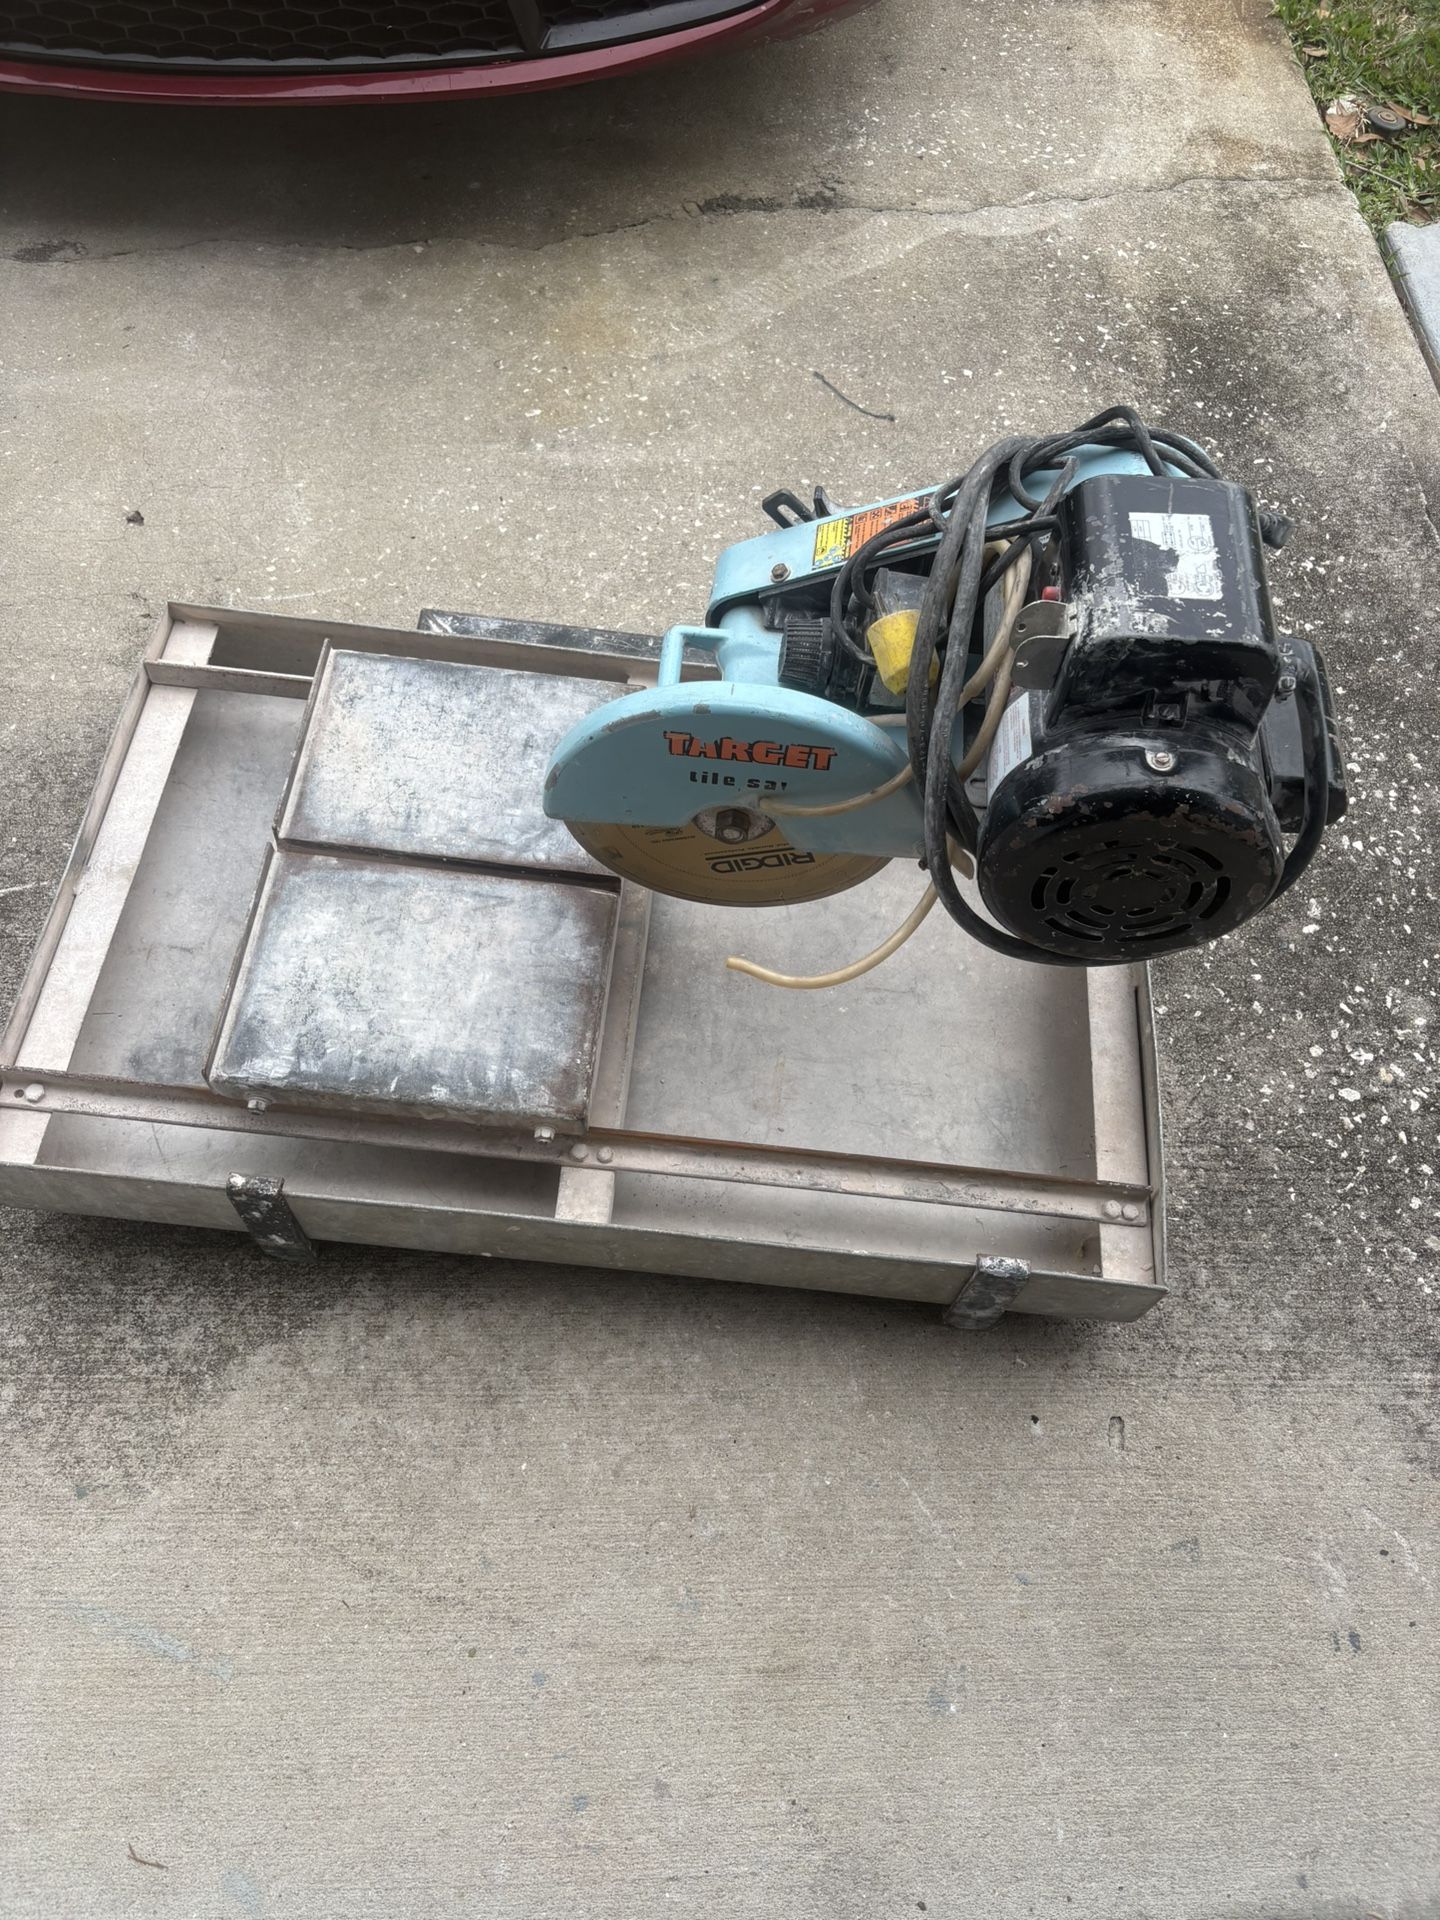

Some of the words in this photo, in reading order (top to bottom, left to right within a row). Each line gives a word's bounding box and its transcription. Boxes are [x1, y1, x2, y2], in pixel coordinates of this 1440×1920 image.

[663, 731, 838, 770] TARGET
[690, 771, 735, 786] tile
[711, 852, 816, 873] RIDGID
